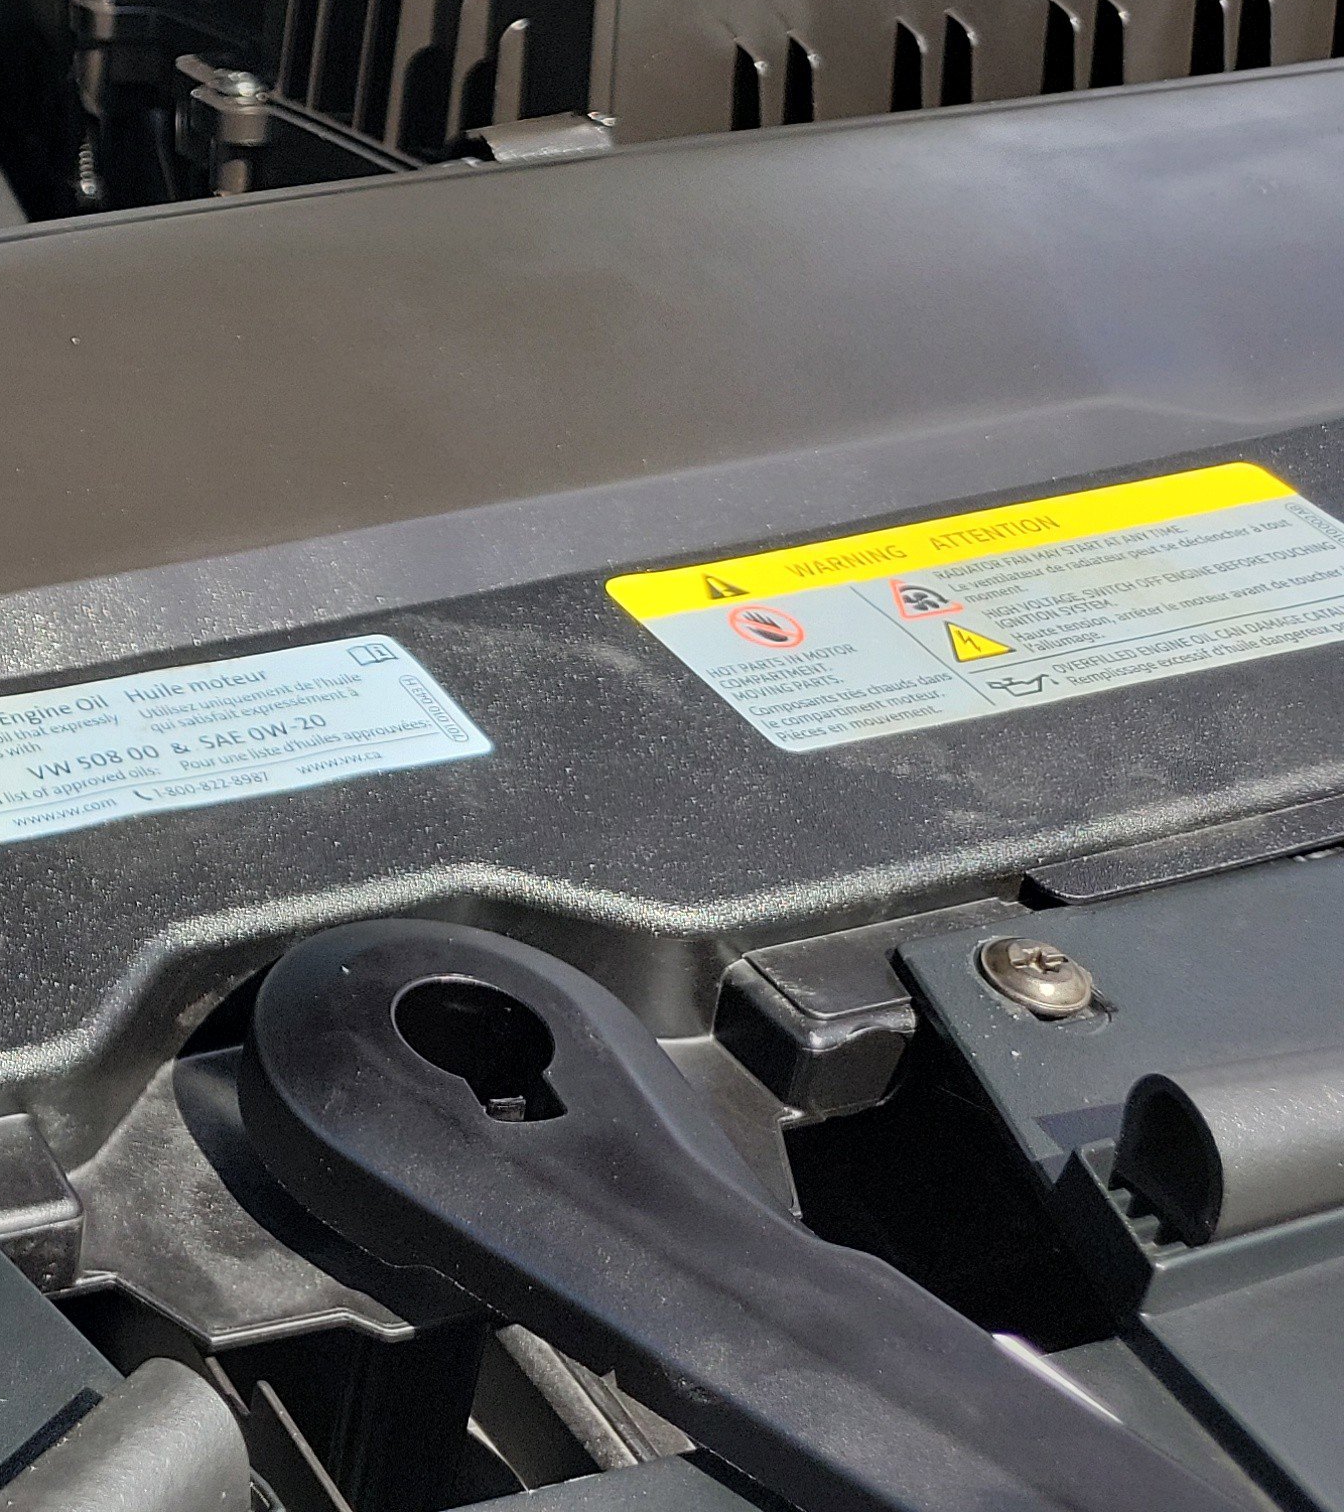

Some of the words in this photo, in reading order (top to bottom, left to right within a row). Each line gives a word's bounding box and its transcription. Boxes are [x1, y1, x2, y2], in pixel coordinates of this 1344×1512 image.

[929, 515, 1060, 550] ATTENTION
[785, 544, 907, 577] WARNING
[932, 559, 1003, 580] RADIATOR
[1001, 554, 1033, 566] FAN
[1030, 548, 1062, 560] MAY
[1059, 539, 1103, 555] START
[1103, 536, 1122, 547] AT
[1120, 531, 1149, 543] ANY
[1146, 524, 1188, 538] TIME.
[947, 583, 970, 592] Le
[967, 568, 1044, 588] ventilateur
[1044, 564, 1065, 573] de
[1063, 552, 1126, 570] radiateur
[1126, 545, 1161, 559] peut
[1159, 543, 1178, 551] se
[1258, 518, 1292, 530] tout
[963, 584, 1028, 603] moment.
[980, 604, 1021, 619] HIGH
[1015, 592, 1086, 611] VOLTAGE,
[1081, 581, 1136, 598] SWITCH
[1134, 575, 1162, 588] OFF
[1161, 565, 1217, 582] ENGINE
[1212, 554, 1269, 572] BEFORE
[1263, 541, 1336, 561] TOUCHING
[994, 609, 1060, 629] IGNITION
[1057, 598, 1117, 616] SYSTEM.
[1009, 627, 1058, 642] Haute
[1055, 615, 1116, 632] tension,
[1160, 602, 1180, 611] le
[1178, 592, 1230, 608] moteur
[1229, 583, 1272, 598] avant
[1269, 580, 1290, 589] de
[1287, 568, 1344, 585] toucher
[1022, 631, 1105, 653] l'allumage.
[705, 664, 738, 678] HOT
[737, 656, 786, 672] PARTS
[782, 654, 804, 664] IN
[801, 643, 857, 661] MOTOR
[719, 662, 832, 689] COMPARTMENT.
[75, 694, 109, 711] Oil
[123, 683, 184, 703] Huile
[187, 670, 266, 692] moteur
[138, 703, 197, 719] Utilisez
[198, 684, 293, 709] uniquement
[293, 681, 314, 691] de
[312, 673, 362, 688] l'huile
[731, 682, 794, 701] MOVING
[748, 694, 839, 716] Composants
[866, 678, 917, 695] chauds
[916, 672, 953, 685] dans
[149, 721, 176, 734] qui
[177, 709, 240, 727] satisfait
[760, 719, 780, 729] le
[780, 699, 886, 726] compartiment
[885, 689, 945, 706] moteur.
[826, 722, 848, 733] en
[848, 705, 942, 728] mouvement.
[13, 725, 49, 740] that
[49, 713, 118, 734] expressly
[5, 741, 42, 756] with
[26, 760, 71, 780] VW
[76, 750, 123, 769] 508
[126, 744, 159, 760] 00
[170, 742, 191, 754] &
[198, 730, 245, 749] SAE
[247, 714, 326, 741] 0W-20
[178, 757, 216, 771] Pour
[217, 753, 249, 764] une
[246, 746, 282, 759] liste
[282, 733, 341, 752] d'huiles
[296, 751, 382, 774] www.vw.ca
[2, 789, 31, 803] list
[31, 786, 49, 798] of
[54, 769, 127, 795] approved
[127, 765, 161, 778] oils:
[152, 771, 268, 797] 1-800-822-8987
[12, 798, 117, 826] www.vw.com
